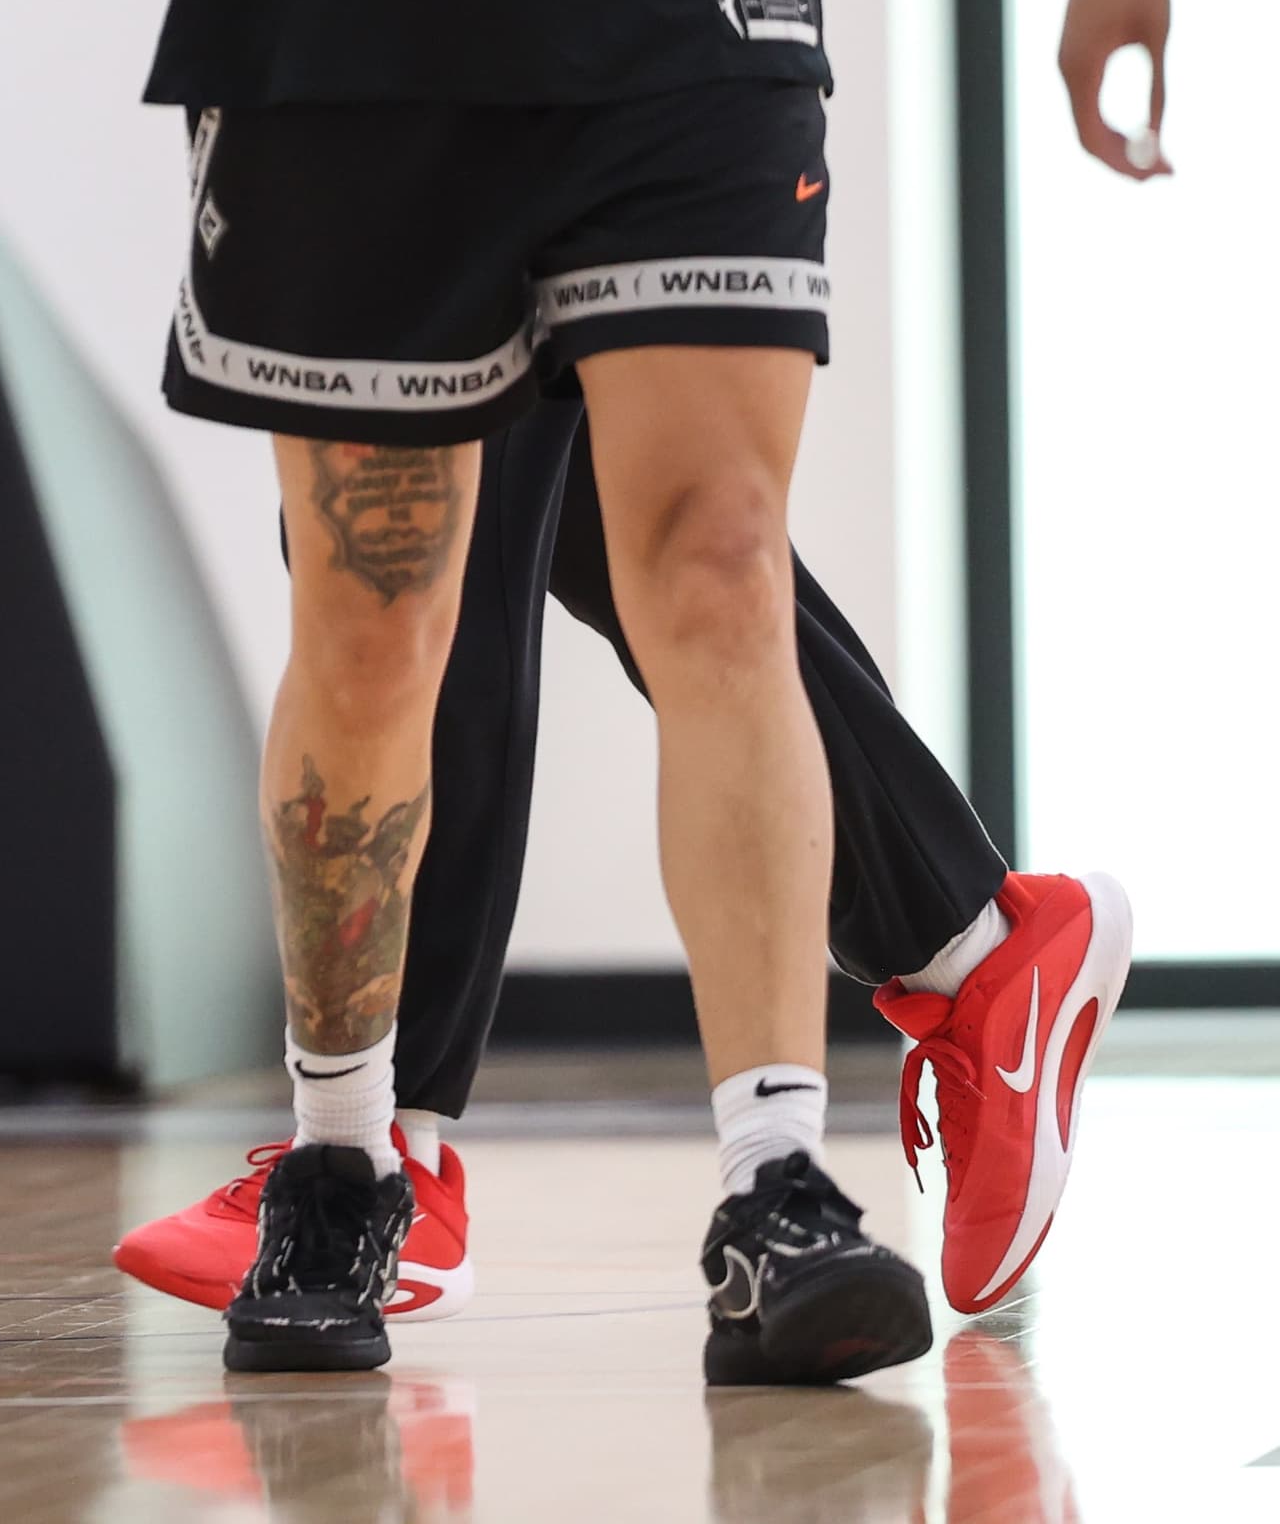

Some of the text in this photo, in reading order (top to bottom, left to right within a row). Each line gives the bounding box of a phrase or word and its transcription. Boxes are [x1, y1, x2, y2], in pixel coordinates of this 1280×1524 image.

[553, 278, 618, 308] WNBA
[661, 271, 773, 293] WNBA
[247, 357, 354, 395] WNBA
[397, 363, 505, 397] WNBA
